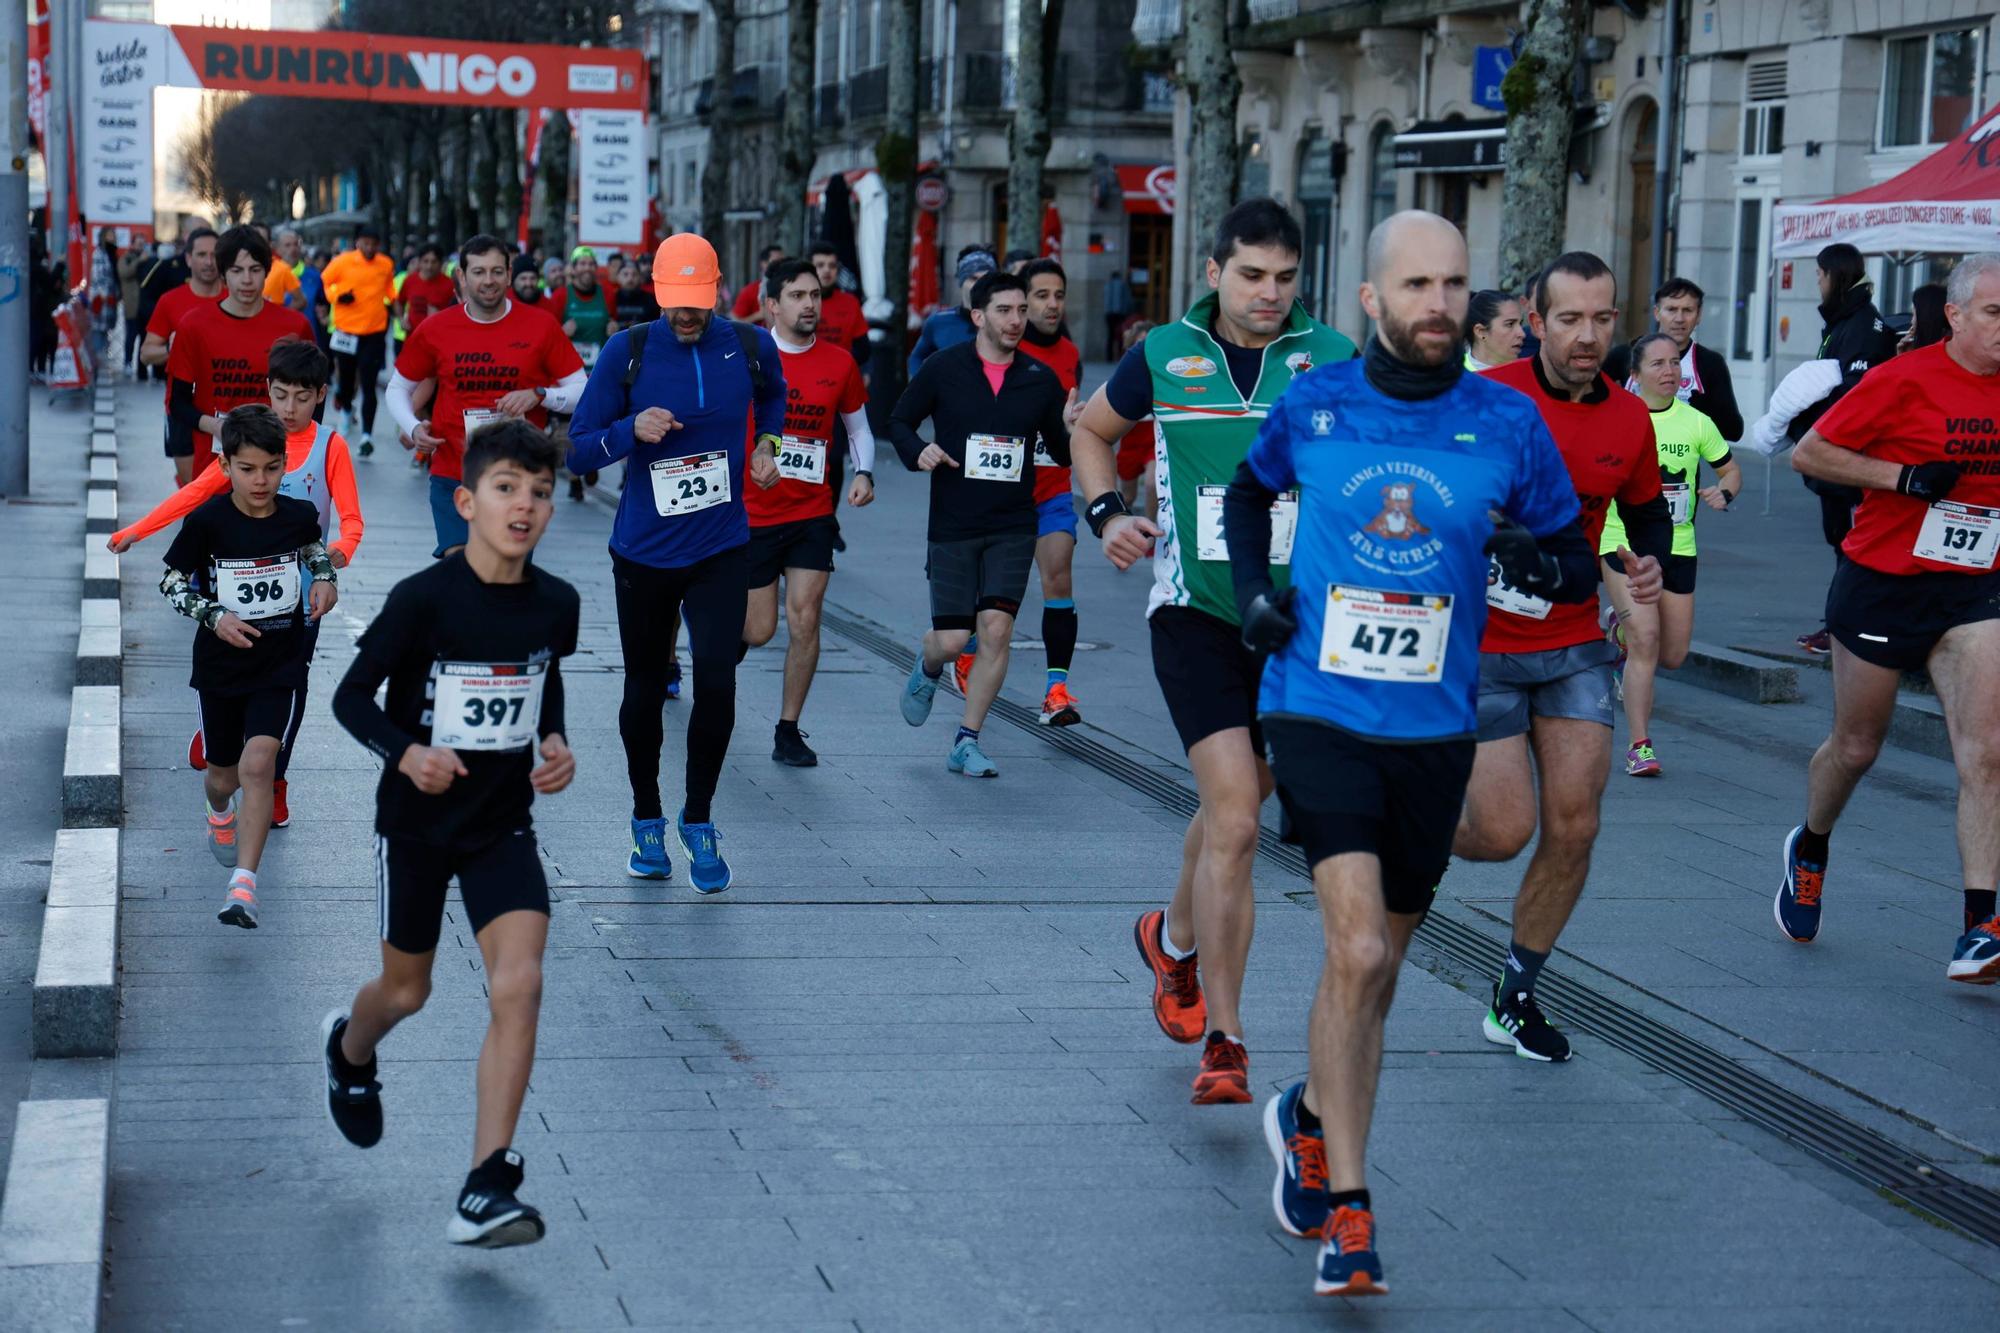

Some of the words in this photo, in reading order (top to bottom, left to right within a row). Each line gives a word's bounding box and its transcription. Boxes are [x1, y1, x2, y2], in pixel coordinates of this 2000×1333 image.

[1864, 207, 1902, 227] SPECIALIZED
[1903, 205, 1938, 223] CONCEPT
[1940, 206, 1966, 224] STORE
[1972, 207, 1992, 225] VIGO
[454, 352, 496, 364] VIGO,
[212, 372, 268, 384] CHANZ
[453, 366, 520, 378] CHANZO
[784, 404, 827, 417] ANZO
[784, 419, 823, 431] RIBA!
[1945, 417, 1999, 435] VIGO,
[1660, 443, 1690, 457] auga
[780, 452, 814, 470] 284
[979, 452, 1013, 469] 283
[677, 476, 708, 500] 23
[1942, 526, 1983, 551] 137
[264, 565, 286, 573] CASTRO
[237, 579, 284, 604] 396
[1351, 624, 1420, 657] 472
[462, 697, 525, 727] 397
